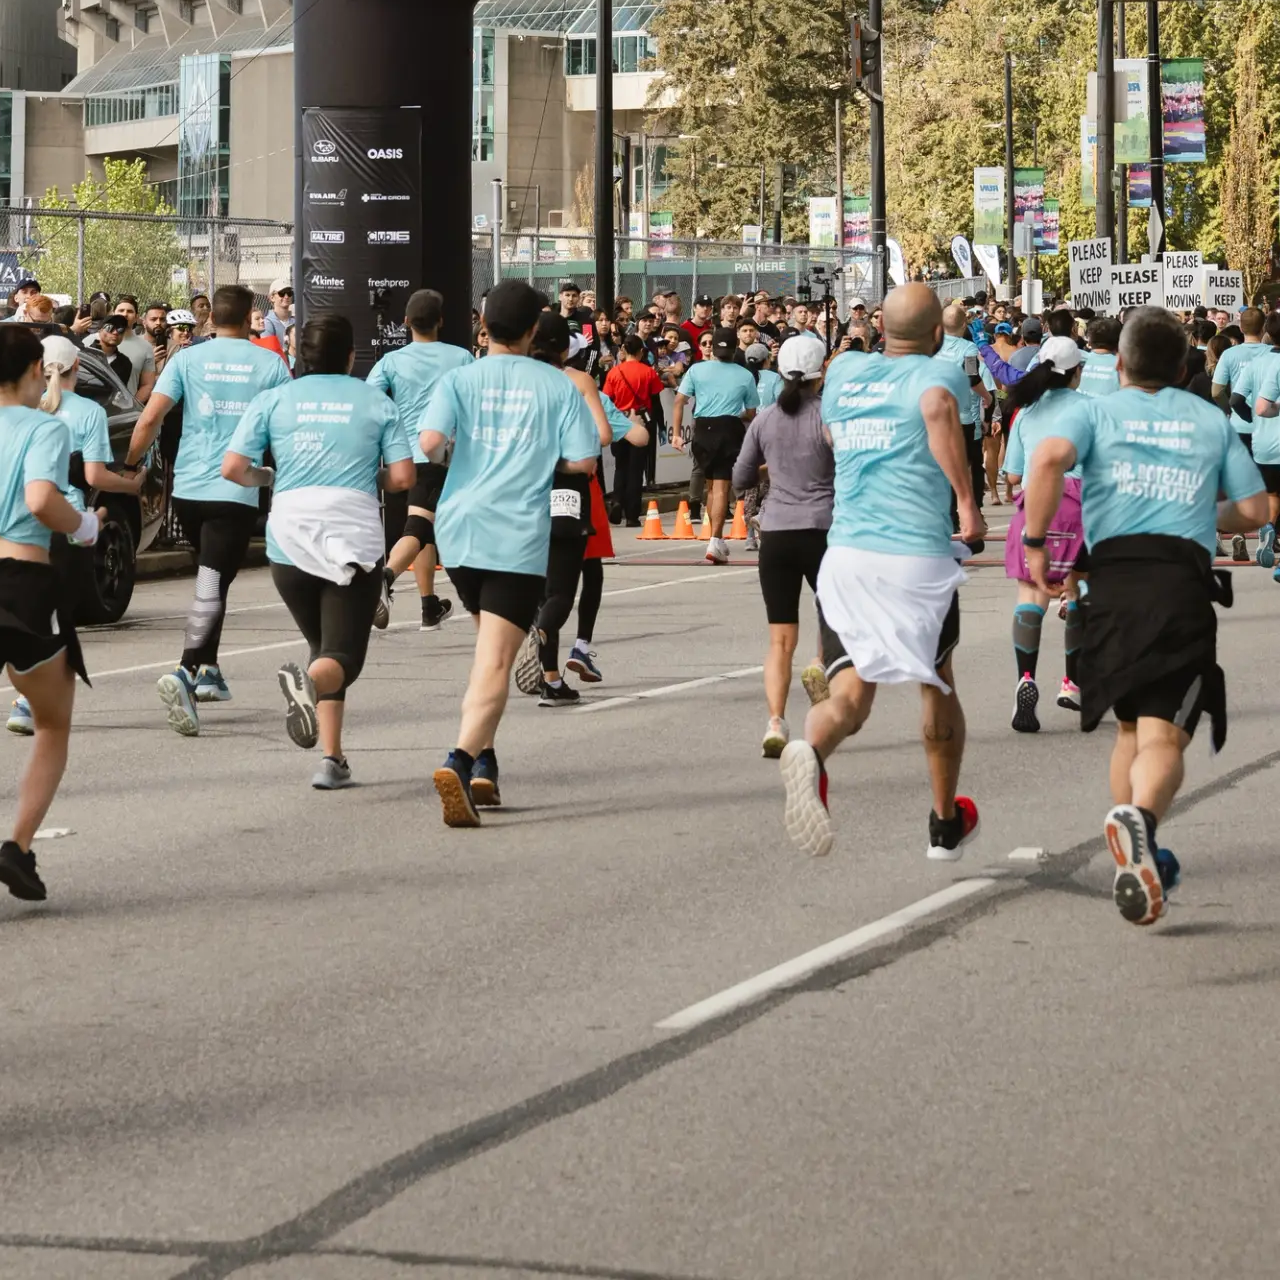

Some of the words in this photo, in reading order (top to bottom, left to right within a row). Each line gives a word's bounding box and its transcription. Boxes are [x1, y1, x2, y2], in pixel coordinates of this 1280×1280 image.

[367, 148, 403, 159] OASIS
[1072, 241, 1108, 263] PLEASE
[734, 262, 754, 272] PAY
[756, 261, 787, 271] HERE
[1166, 253, 1199, 269] PLEASE
[320, 275, 345, 287] kintec
[1079, 267, 1103, 285] KEEP
[1110, 270, 1159, 285] PLEASE
[1172, 274, 1194, 289] KEEP
[1209, 275, 1241, 289] PLEASE
[367, 277, 410, 289] freshprep
[1073, 289, 1111, 309] MOVING
[1118, 291, 1152, 306] KEEP
[1166, 293, 1202, 308] MOVING
[1214, 294, 1237, 307] KEEP
[382, 338, 407, 346] PLACE
[225, 363, 253, 373] TEAM
[204, 373, 250, 384] DIVISION
[215, 400, 248, 410] SURRE
[320, 401, 354, 412] TEAM
[297, 413, 350, 425] DIVISION
[294, 431, 326, 443] EMILY
